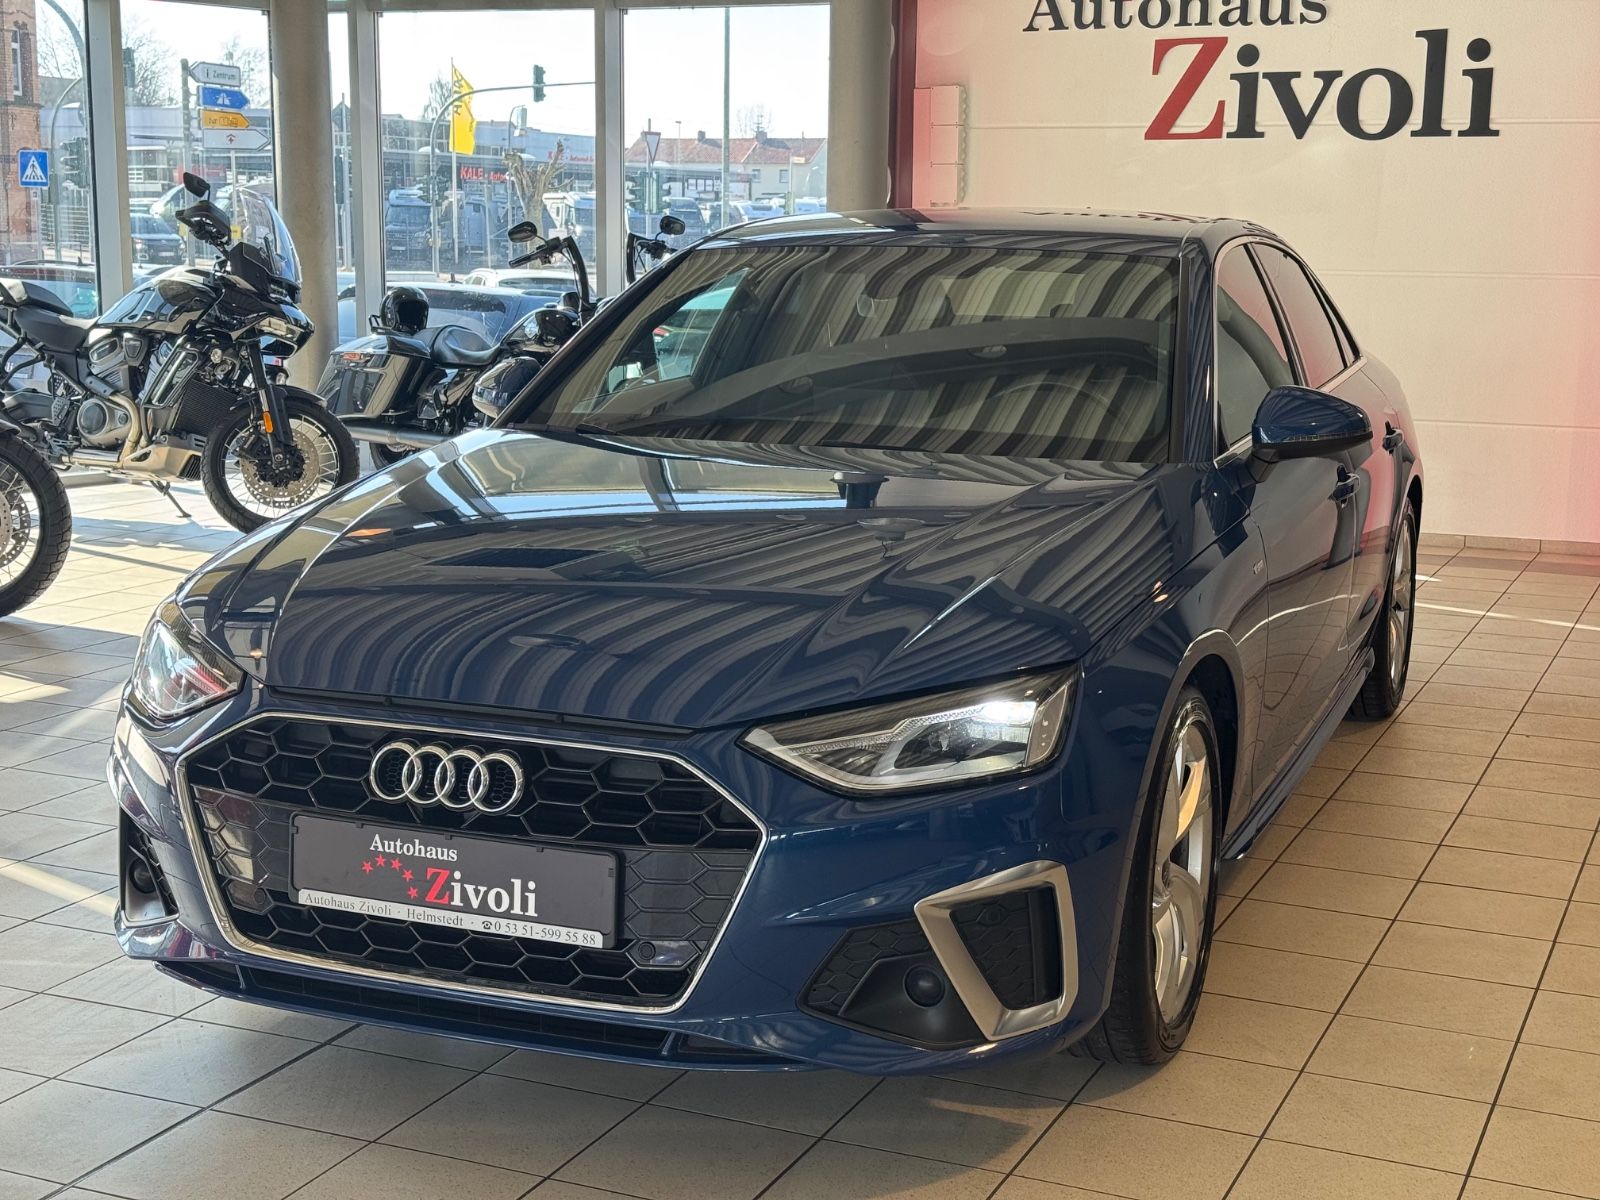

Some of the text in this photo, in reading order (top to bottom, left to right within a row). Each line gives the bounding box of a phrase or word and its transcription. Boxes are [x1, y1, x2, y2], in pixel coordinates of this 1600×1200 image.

[1022, 0, 1328, 32] Autohaus
[212, 69, 236, 80] Zentrum
[1144, 28, 1500, 141] Zivoli
[460, 167, 484, 180] KALE
[370, 833, 458, 862] Autohaus
[425, 867, 538, 917] Zivoli
[304, 893, 355, 911] Autohaus
[359, 900, 392, 916] Zivoli
[407, 908, 464, 927] Helmstedt
[505, 922, 518, 934] 53
[521, 925, 562, 940] 51-599
[565, 930, 579, 943] 55
[582, 933, 596, 945] 88
